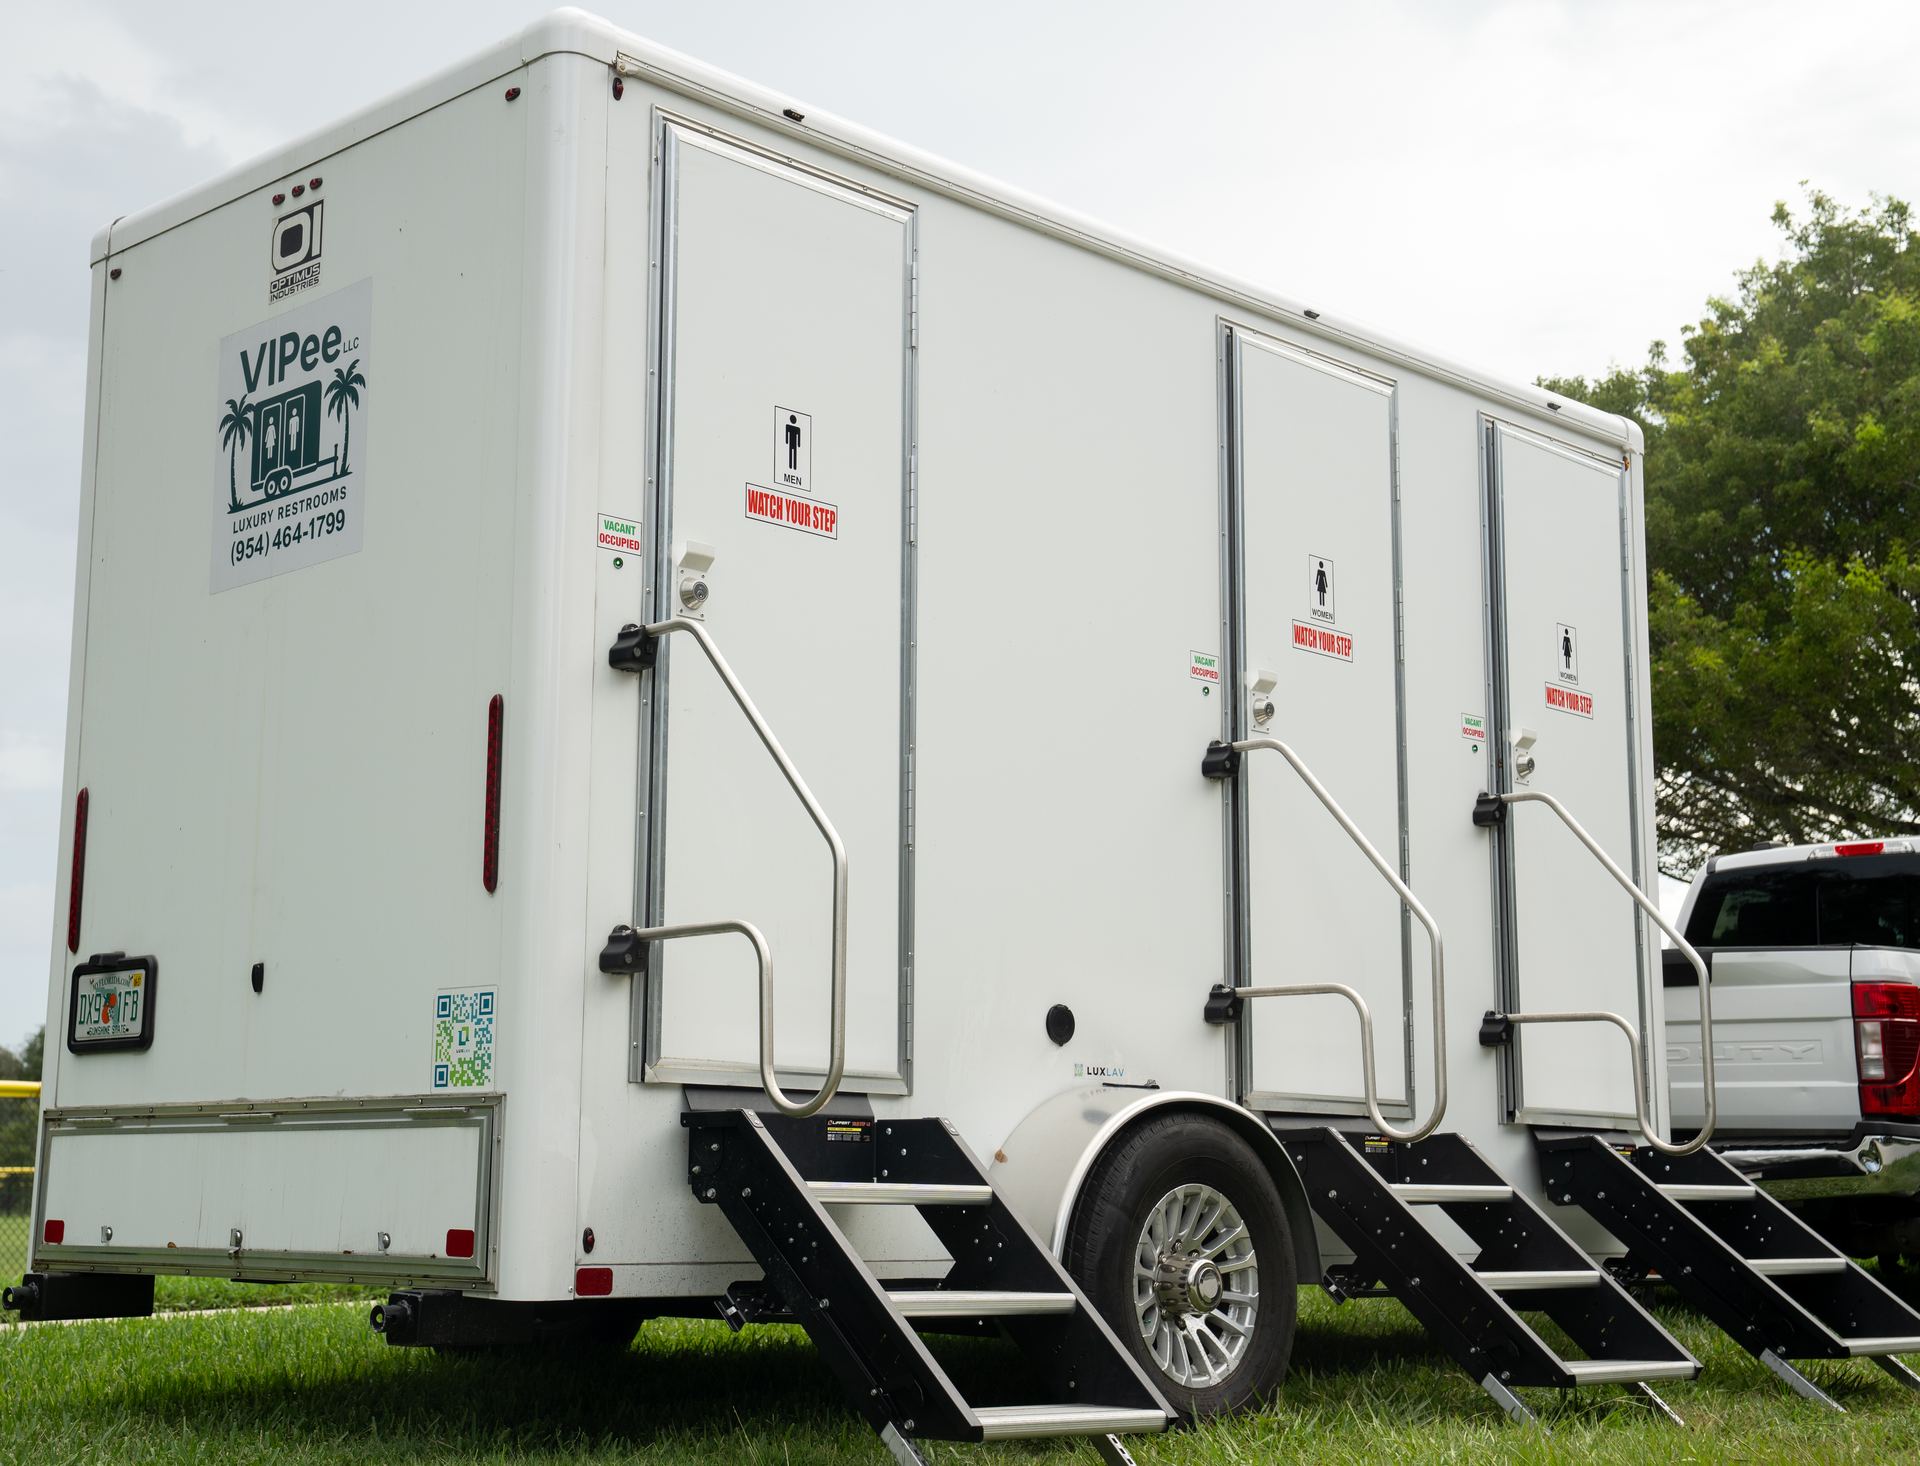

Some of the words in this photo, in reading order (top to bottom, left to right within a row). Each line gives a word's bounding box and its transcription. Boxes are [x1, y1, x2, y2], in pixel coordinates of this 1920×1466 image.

[270, 262, 321, 293] OPTIMUS
[270, 276, 320, 302] INDUSTRIES
[240, 325, 342, 394] VIPee
[343, 337, 360, 353] LLC
[784, 473, 802, 486] MEN
[233, 509, 274, 534] LUXURY
[277, 486, 347, 520] RESTROOMS
[747, 488, 784, 521] WATCH
[785, 499, 811, 528] YOUR
[812, 505, 837, 533] STEP
[603, 519, 637, 536] VACANT
[231, 531, 270, 566] (954)
[272, 509, 346, 550] 464-1799
[599, 532, 640, 551] OCCUPIED
[1311, 608, 1333, 620] WOMEN
[1294, 624, 1317, 649] WATCH
[1318, 631, 1336, 653] YOUR
[1336, 635, 1352, 657] STEP
[1194, 655, 1216, 667] VACANT
[1191, 665, 1219, 680] OCCUPIED
[1560, 671, 1577, 682] WOMEN
[1546, 687, 1565, 708] WATCH
[1565, 692, 1579, 712] YOUR
[1579, 695, 1593, 715] STEP
[1464, 717, 1482, 728] VACANT
[1462, 727, 1485, 739] OCCUPIED
